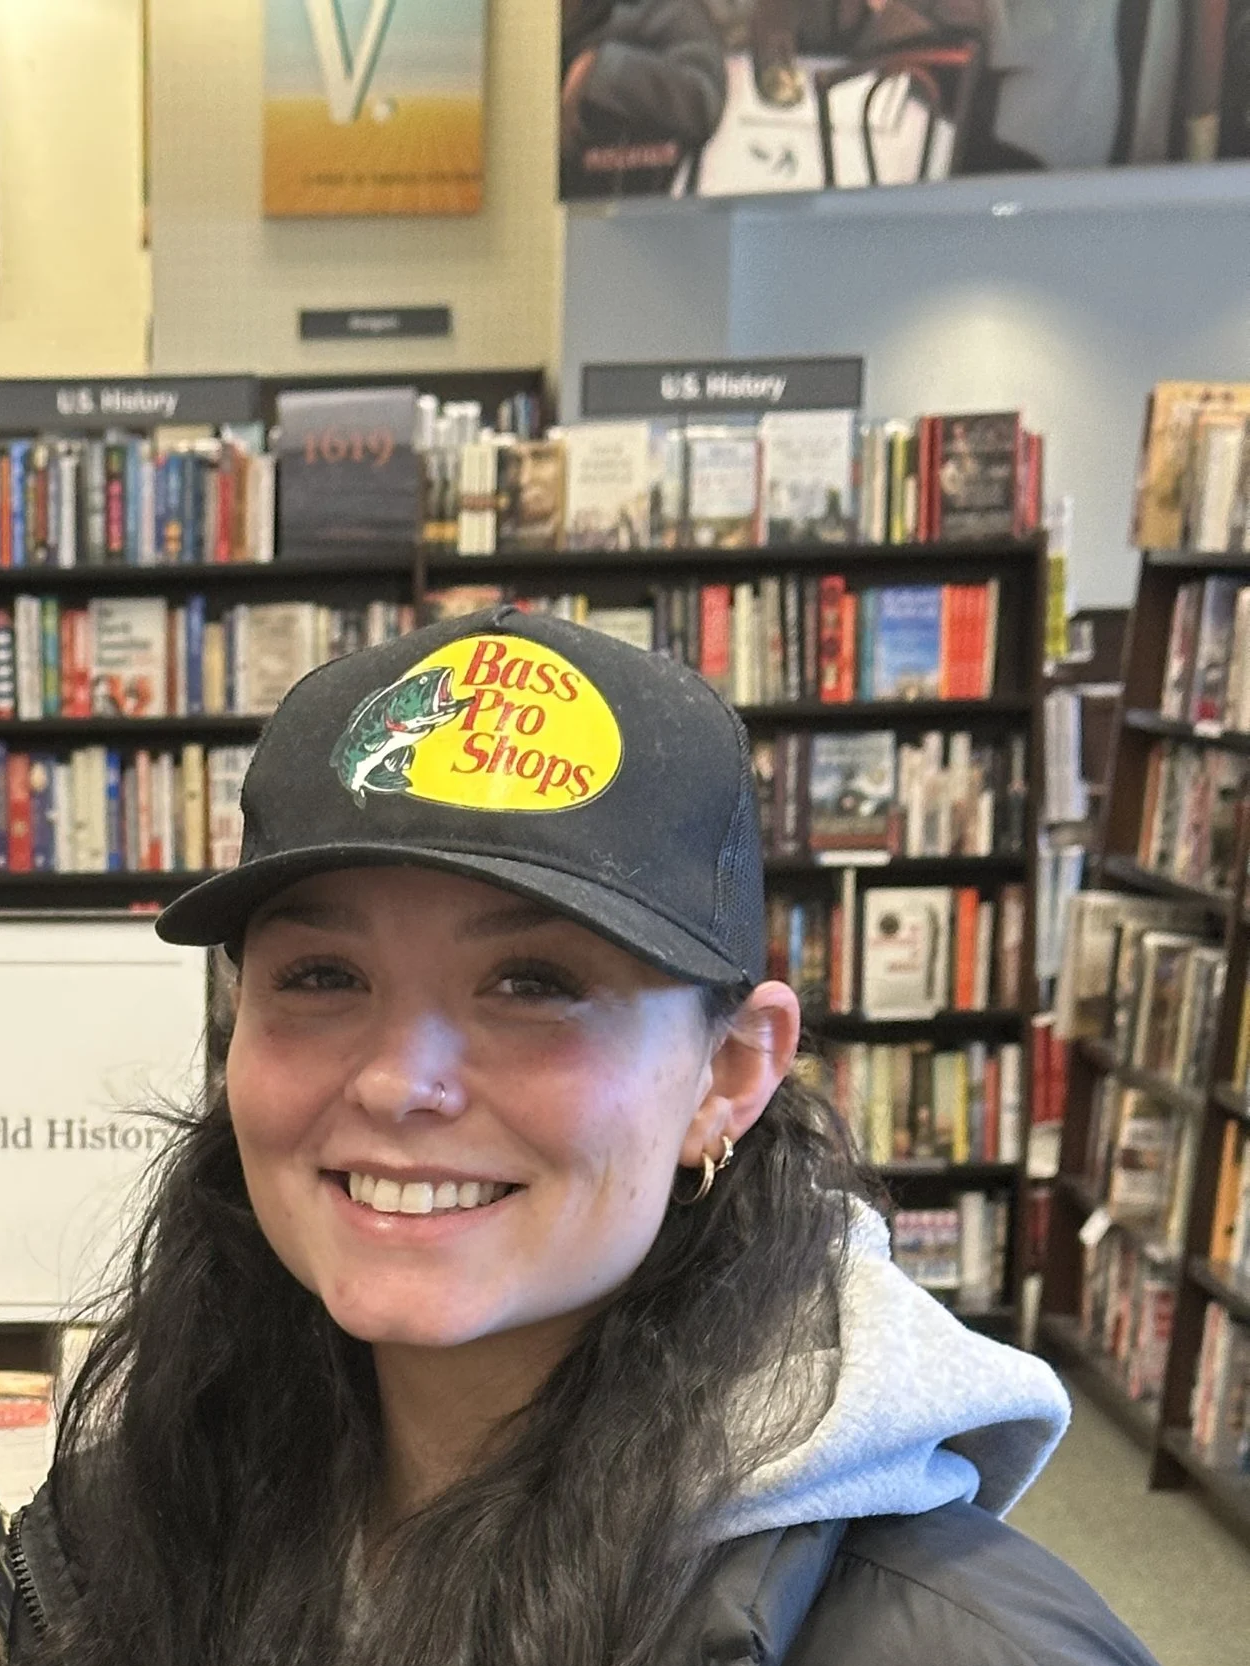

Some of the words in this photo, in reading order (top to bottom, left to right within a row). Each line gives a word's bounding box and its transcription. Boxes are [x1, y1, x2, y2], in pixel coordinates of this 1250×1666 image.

[56, 389, 94, 415] U.S.
[100, 387, 179, 418] History
[660, 374, 700, 401] U.S.
[707, 372, 787, 404] History
[303, 425, 396, 468] 1619
[460, 640, 581, 702] Bass
[460, 688, 546, 736] Pro
[451, 732, 595, 801] Shops
